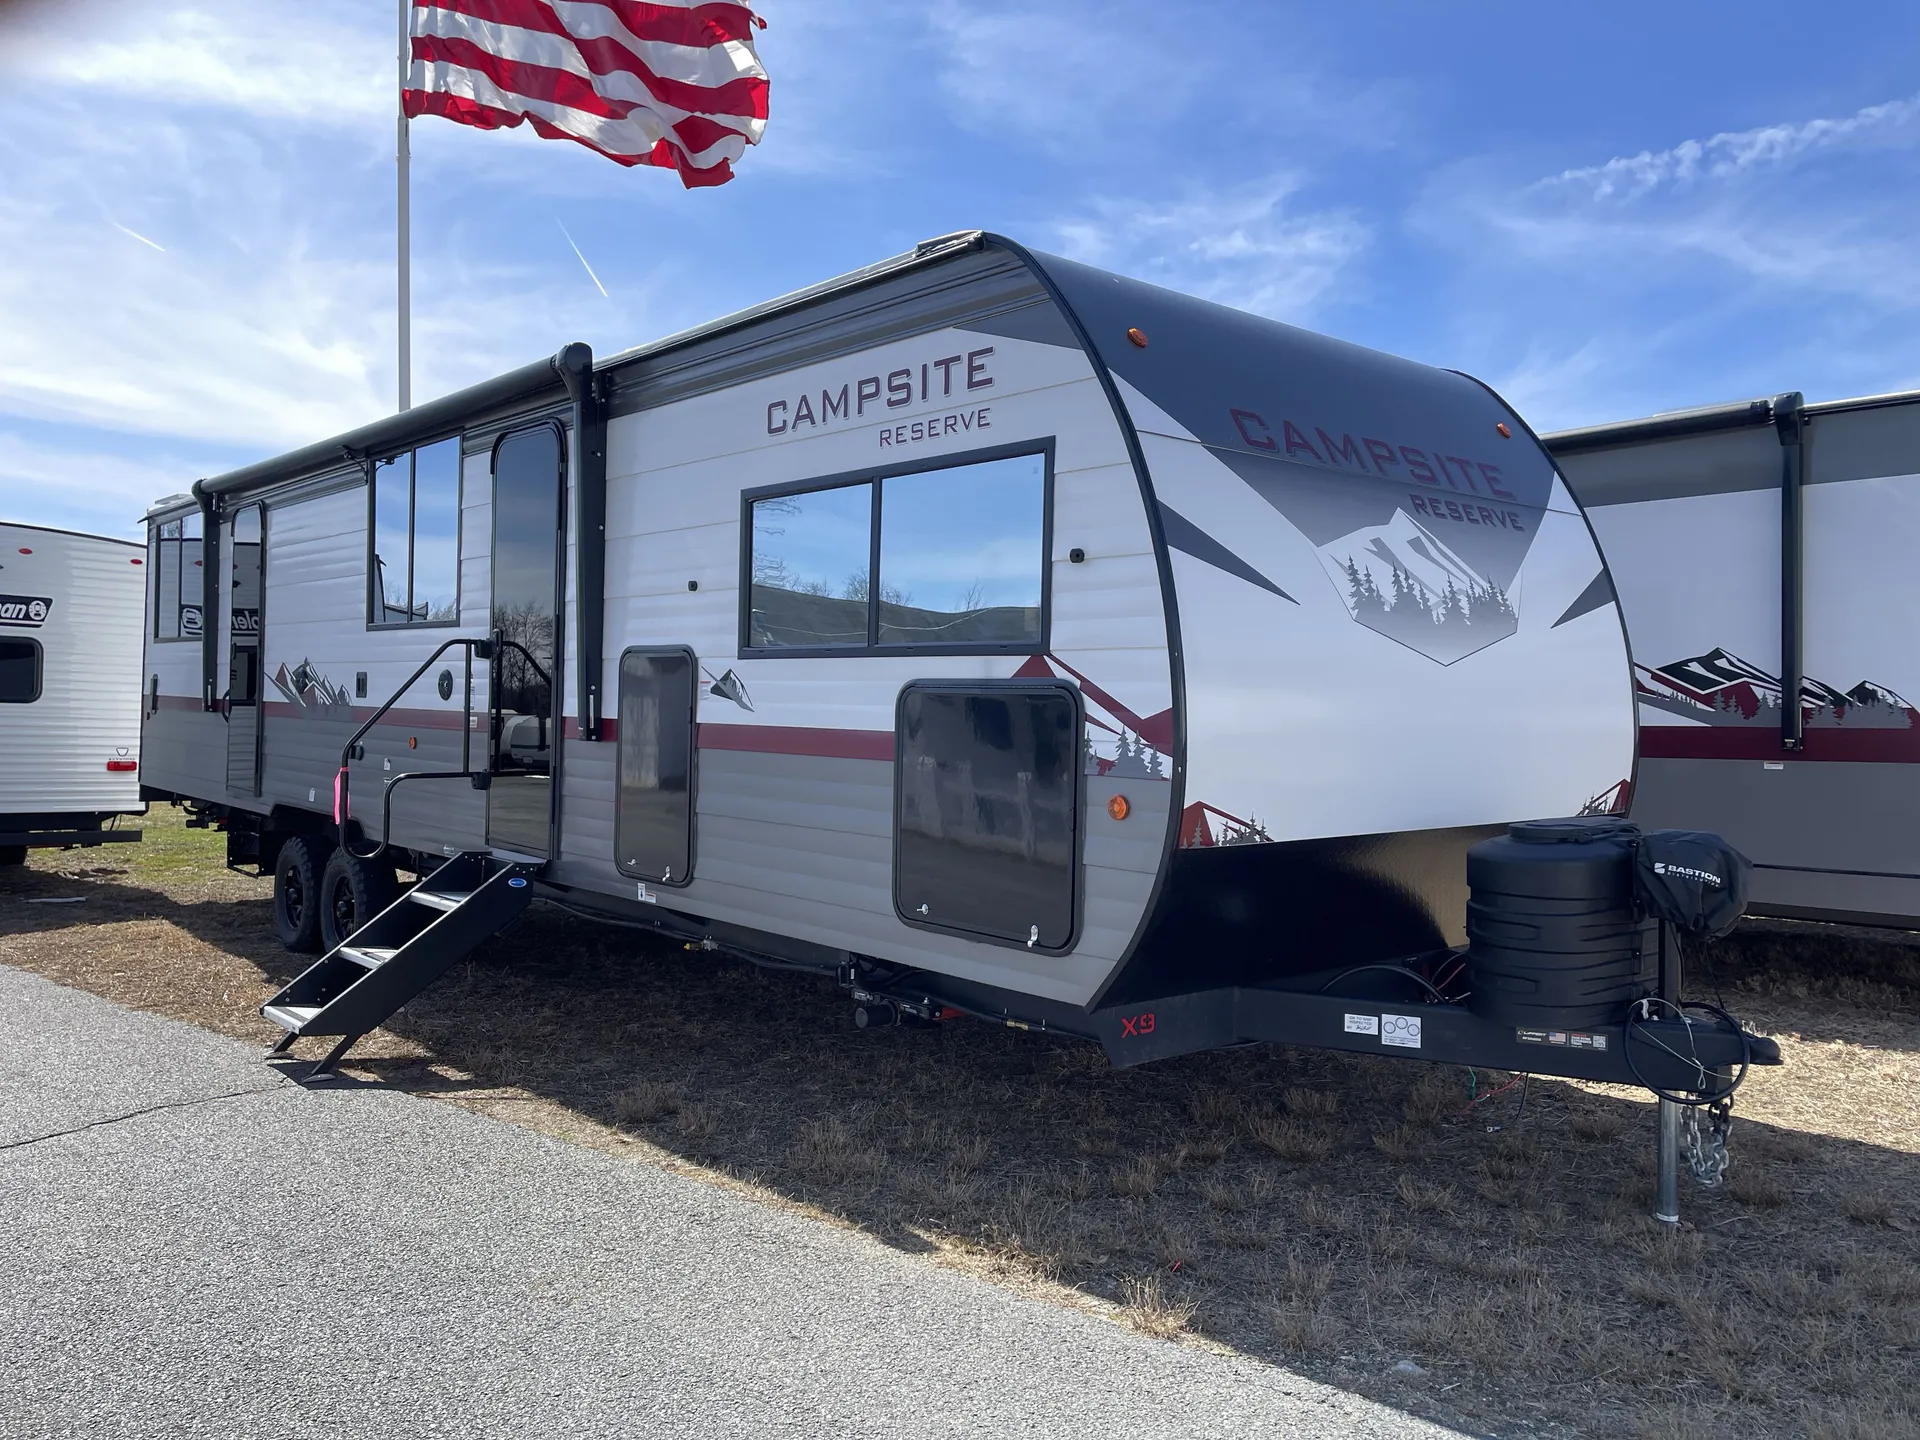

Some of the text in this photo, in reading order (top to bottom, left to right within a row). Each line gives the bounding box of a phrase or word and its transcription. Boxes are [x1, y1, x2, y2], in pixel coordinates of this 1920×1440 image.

[767, 346, 994, 435] CAMPSITE
[879, 407, 992, 448] RESERVE
[1229, 408, 1517, 499] CAMPSITE
[1408, 493, 1526, 532] RESERVE
[0, 602, 27, 619] an
[1668, 864, 1721, 883] BASTION
[1121, 1013, 1155, 1038] X9
